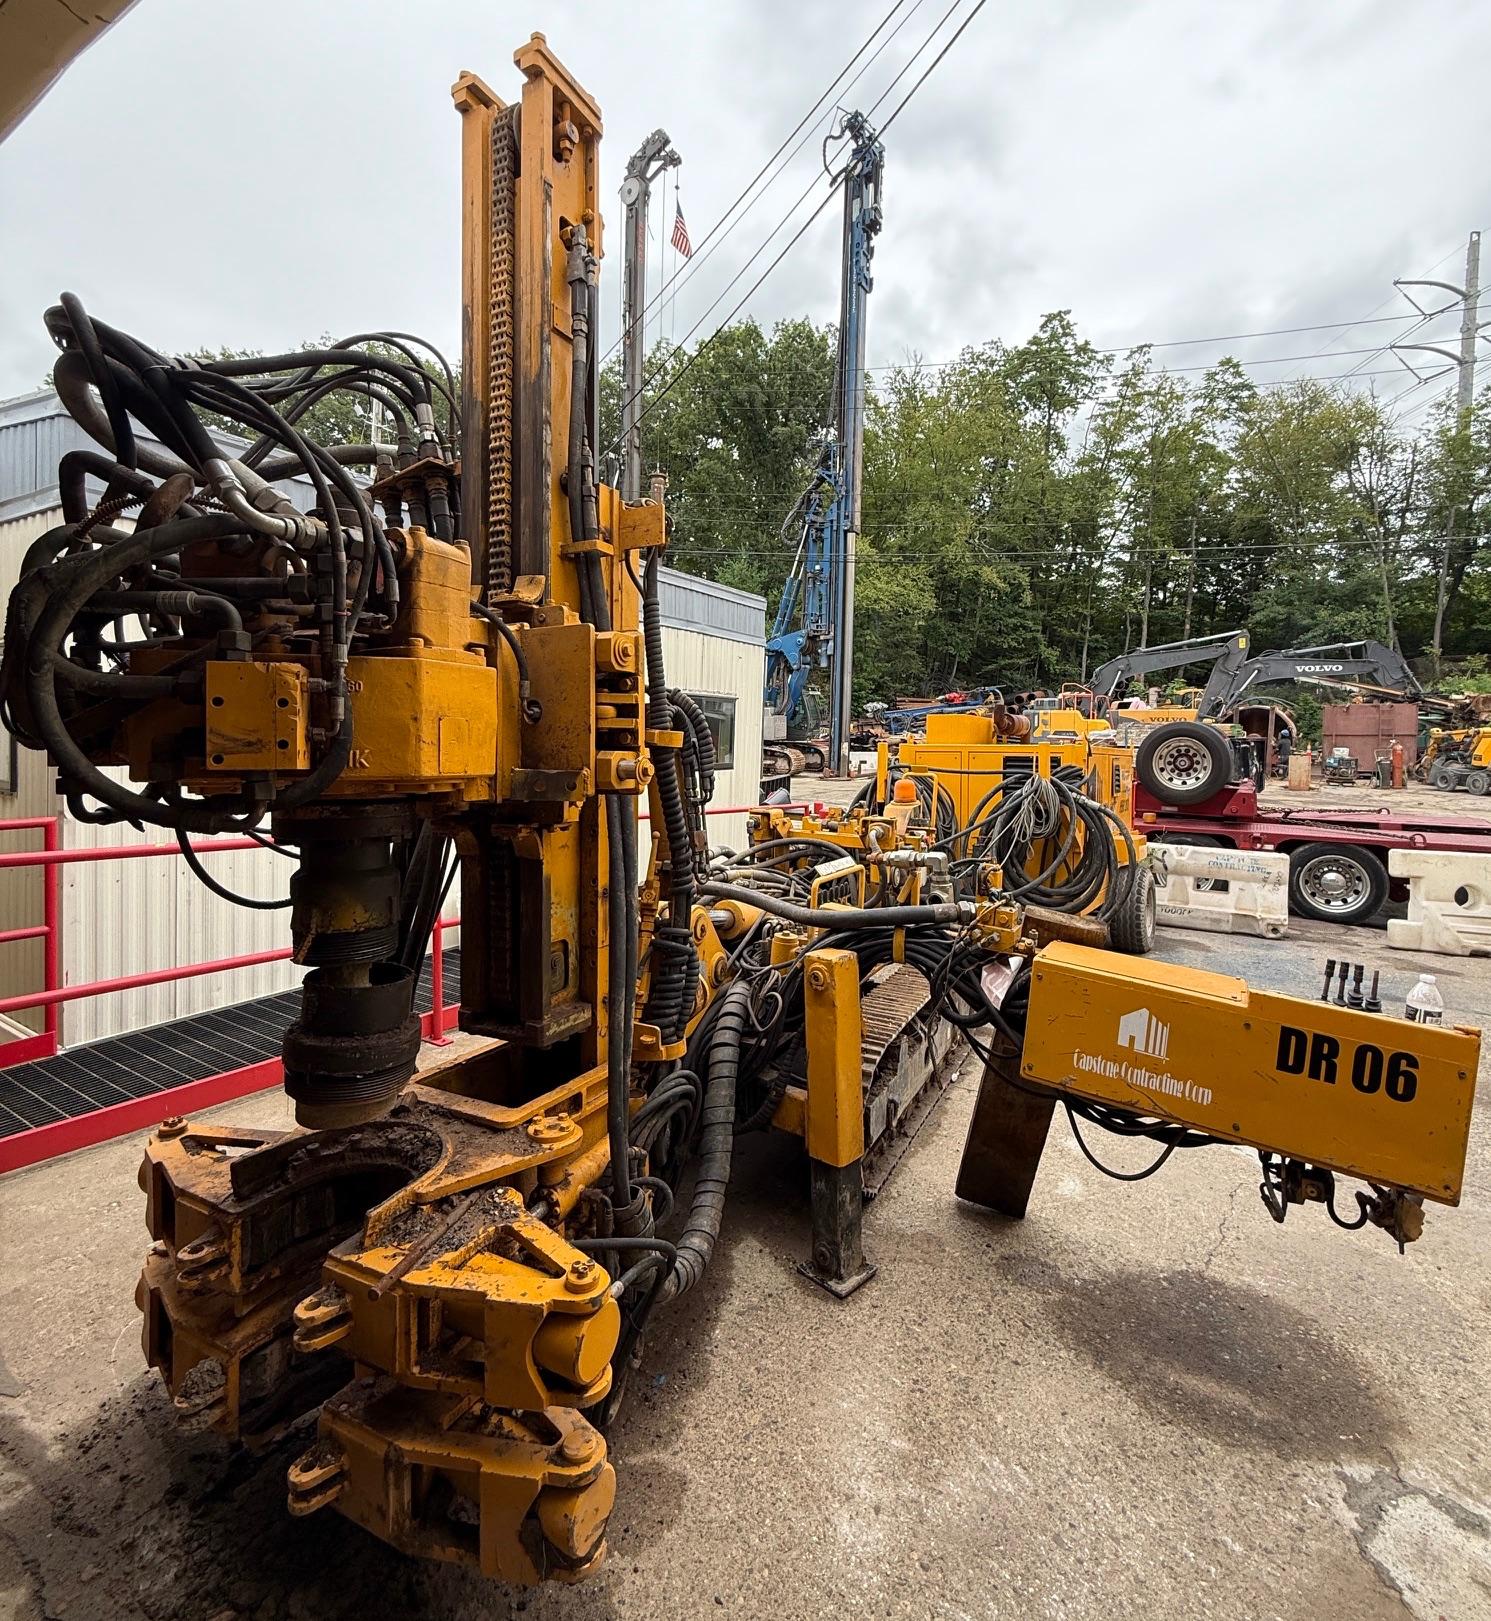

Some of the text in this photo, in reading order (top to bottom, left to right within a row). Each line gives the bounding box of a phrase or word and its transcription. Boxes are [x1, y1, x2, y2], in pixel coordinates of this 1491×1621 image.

[1295, 664, 1343, 672] VOLVO
[1073, 1048, 1213, 1106] Capstone Contracting Corp
[1275, 1024, 1420, 1103] DR 06
